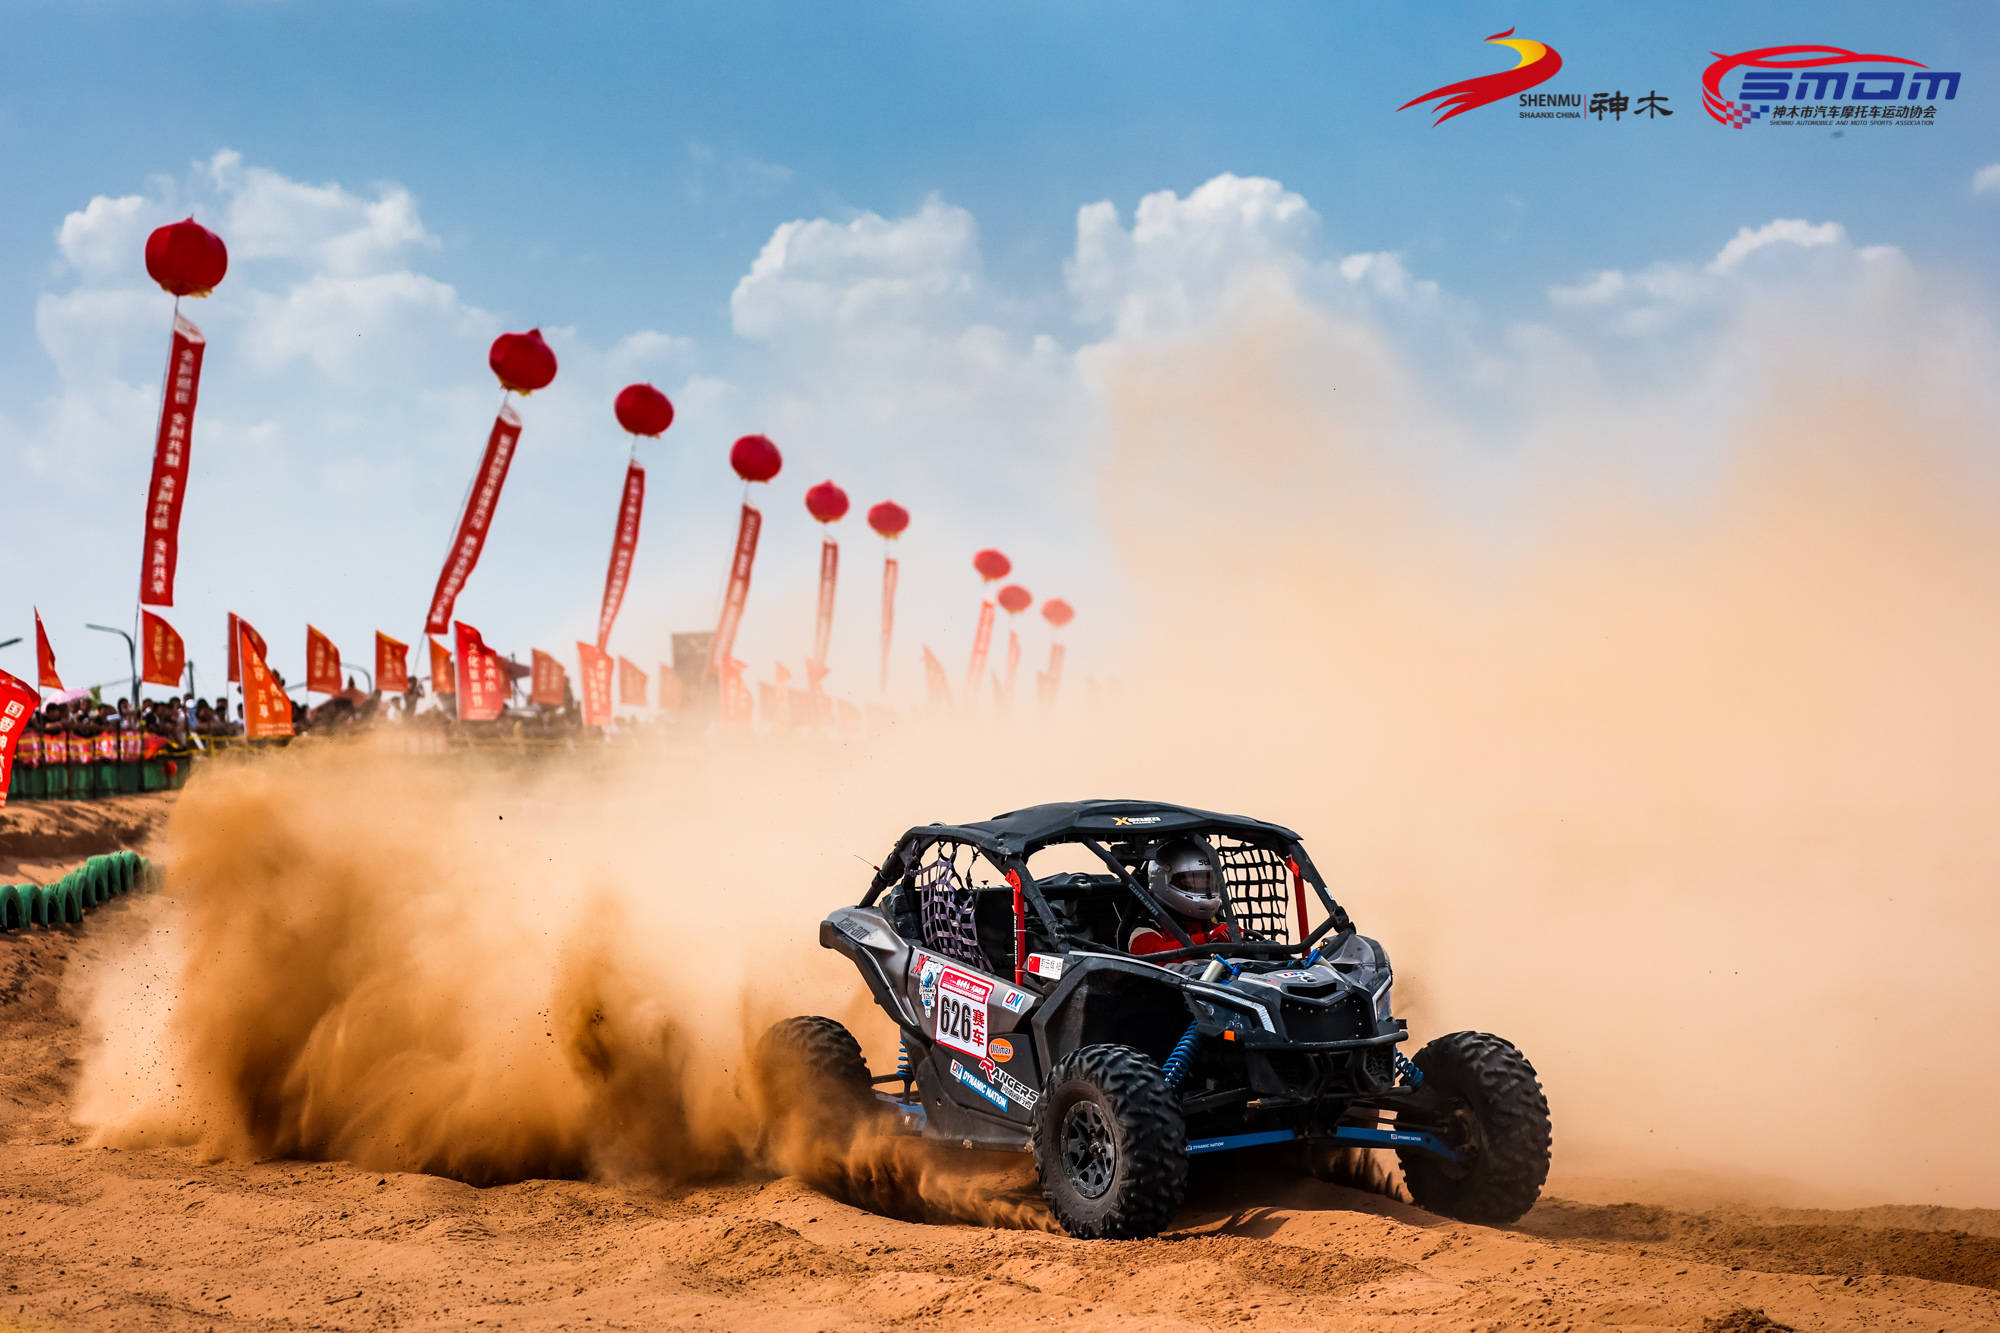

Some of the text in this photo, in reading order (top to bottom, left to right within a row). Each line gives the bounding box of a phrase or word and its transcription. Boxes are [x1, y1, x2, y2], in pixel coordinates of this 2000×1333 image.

[1006, 992, 1023, 1007] DN
[940, 995, 971, 1043] 626
[972, 1008, 985, 1047] 赛车
[962, 1070, 987, 1093] DYNAMIC
[985, 1088, 1007, 1108] NATION
